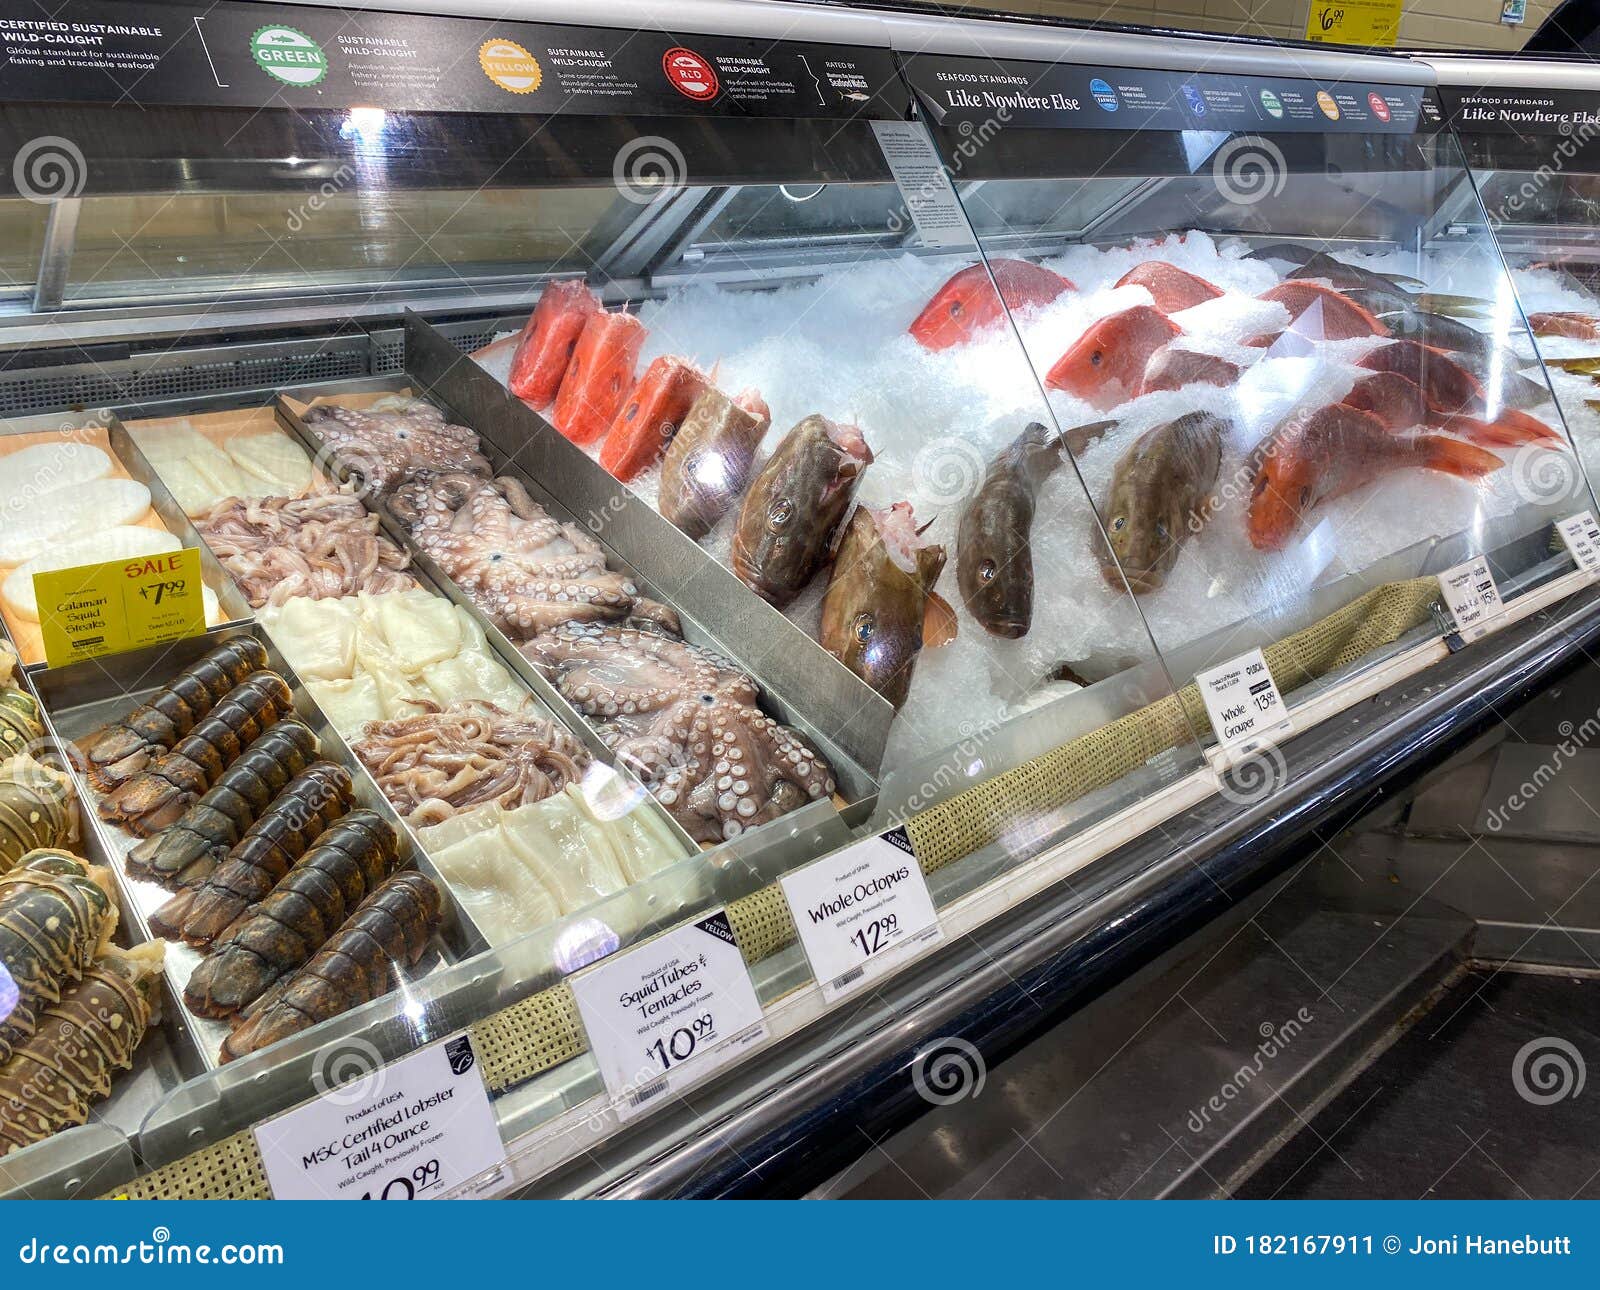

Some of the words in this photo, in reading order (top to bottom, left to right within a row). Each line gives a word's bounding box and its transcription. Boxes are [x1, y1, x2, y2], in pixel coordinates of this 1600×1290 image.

[0, 20, 69, 31] CERTIFIED
[72, 23, 163, 37] SUSTAINABLE
[1, 32, 103, 46] WILD-CAUGHT
[337, 36, 408, 47] SUSTAINABLE
[6, 47, 40, 55] Global
[42, 48, 87, 57] standard
[88, 50, 103, 58] for
[106, 51, 160, 61] sustainable
[258, 49, 321, 64] GREEN
[341, 46, 417, 58] WILD-CAUGHT
[547, 48, 606, 58] SUSTAINABLE
[9, 56, 45, 66] fishing
[47, 58, 66, 66] and
[68, 60, 115, 68] traceable
[117, 61, 155, 70] seafood
[487, 63, 535, 72] YELLOW
[550, 58, 613, 68] WILD-CAUGHT
[716, 56, 764, 66] SUSTAINABLE
[719, 65, 771, 75] WILD-CAUGHT
[936, 72, 978, 82] SEAFOOD
[979, 75, 1029, 85] STANDARDS
[946, 89, 981, 108] Like
[983, 91, 1051, 110] Nowhere
[1050, 94, 1081, 111] Else
[1503, 98, 1554, 106] STANDARDS
[1462, 108, 1496, 120] Like
[1499, 109, 1569, 123] Nowhere
[124, 554, 183, 579] SALE
[56, 597, 107, 613] Calamari
[66, 609, 101, 624] Squid
[64, 620, 106, 635] Steaks
[1220, 703, 1247, 722] Whole
[1224, 717, 1255, 739] Grouper
[887, 834, 912, 852] YELLOW
[808, 891, 855, 924] Whole
[853, 866, 910, 902] Octopus
[704, 922, 734, 942] YELLOW
[641, 967, 662, 981] Product
[661, 963, 669, 972] of
[668, 958, 680, 969] USA
[619, 979, 660, 1008] Squid
[658, 960, 699, 988] Tubes
[636, 979, 703, 1019] Tentacles
[636, 1024, 650, 1035] Wild
[650, 1015, 670, 1030] Caught,
[670, 1001, 697, 1018] Previously
[696, 991, 714, 1005] Frozen
[345, 1103, 378, 1126] Product
[376, 1099, 386, 1111] of
[386, 1091, 405, 1105] USA
[302, 1139, 341, 1171] MSC
[342, 1110, 404, 1150] Certified
[404, 1086, 456, 1120] Lobster
[342, 1144, 370, 1170] Tail
[371, 1141, 383, 1158] 4
[384, 1118, 430, 1150] Ounce
[337, 1176, 355, 1190] Wild
[356, 1162, 385, 1181] Caught,
[385, 1144, 420, 1166] Previously
[420, 1131, 444, 1151] Frozen
